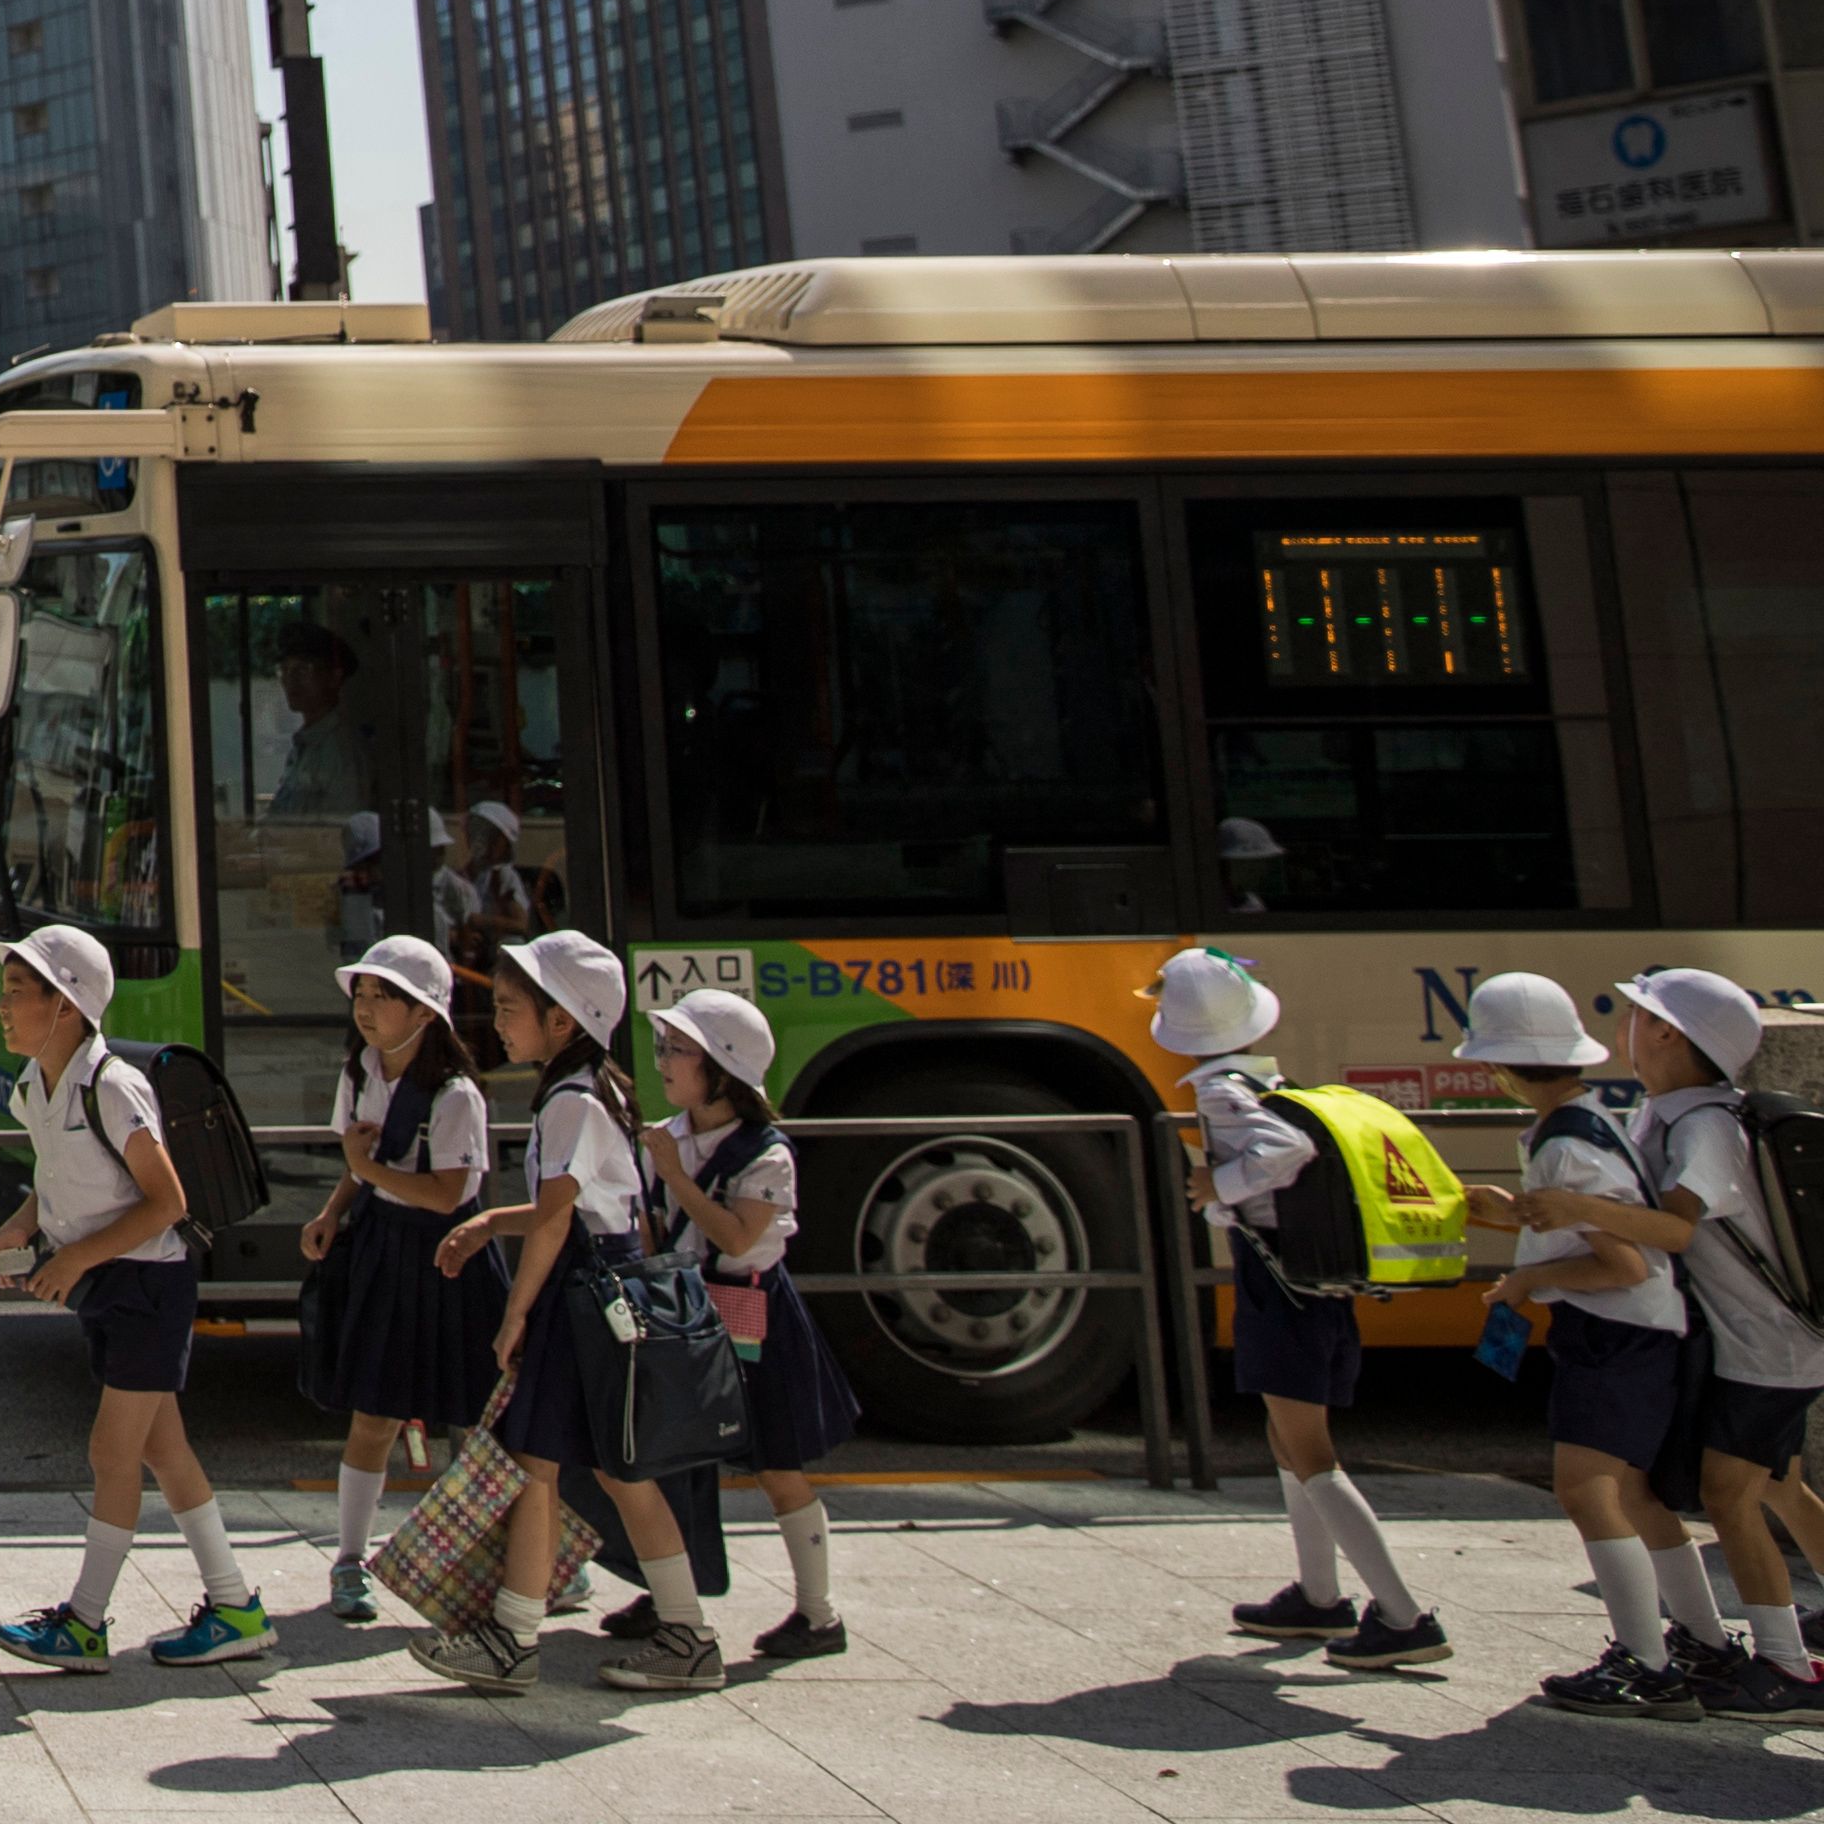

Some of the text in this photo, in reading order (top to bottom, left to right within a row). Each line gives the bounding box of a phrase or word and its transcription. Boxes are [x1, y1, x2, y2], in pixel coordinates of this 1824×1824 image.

[680, 954, 741, 984] 入口
[759, 959, 928, 998] S-B781
[1435, 1071, 1497, 1093] PAS
